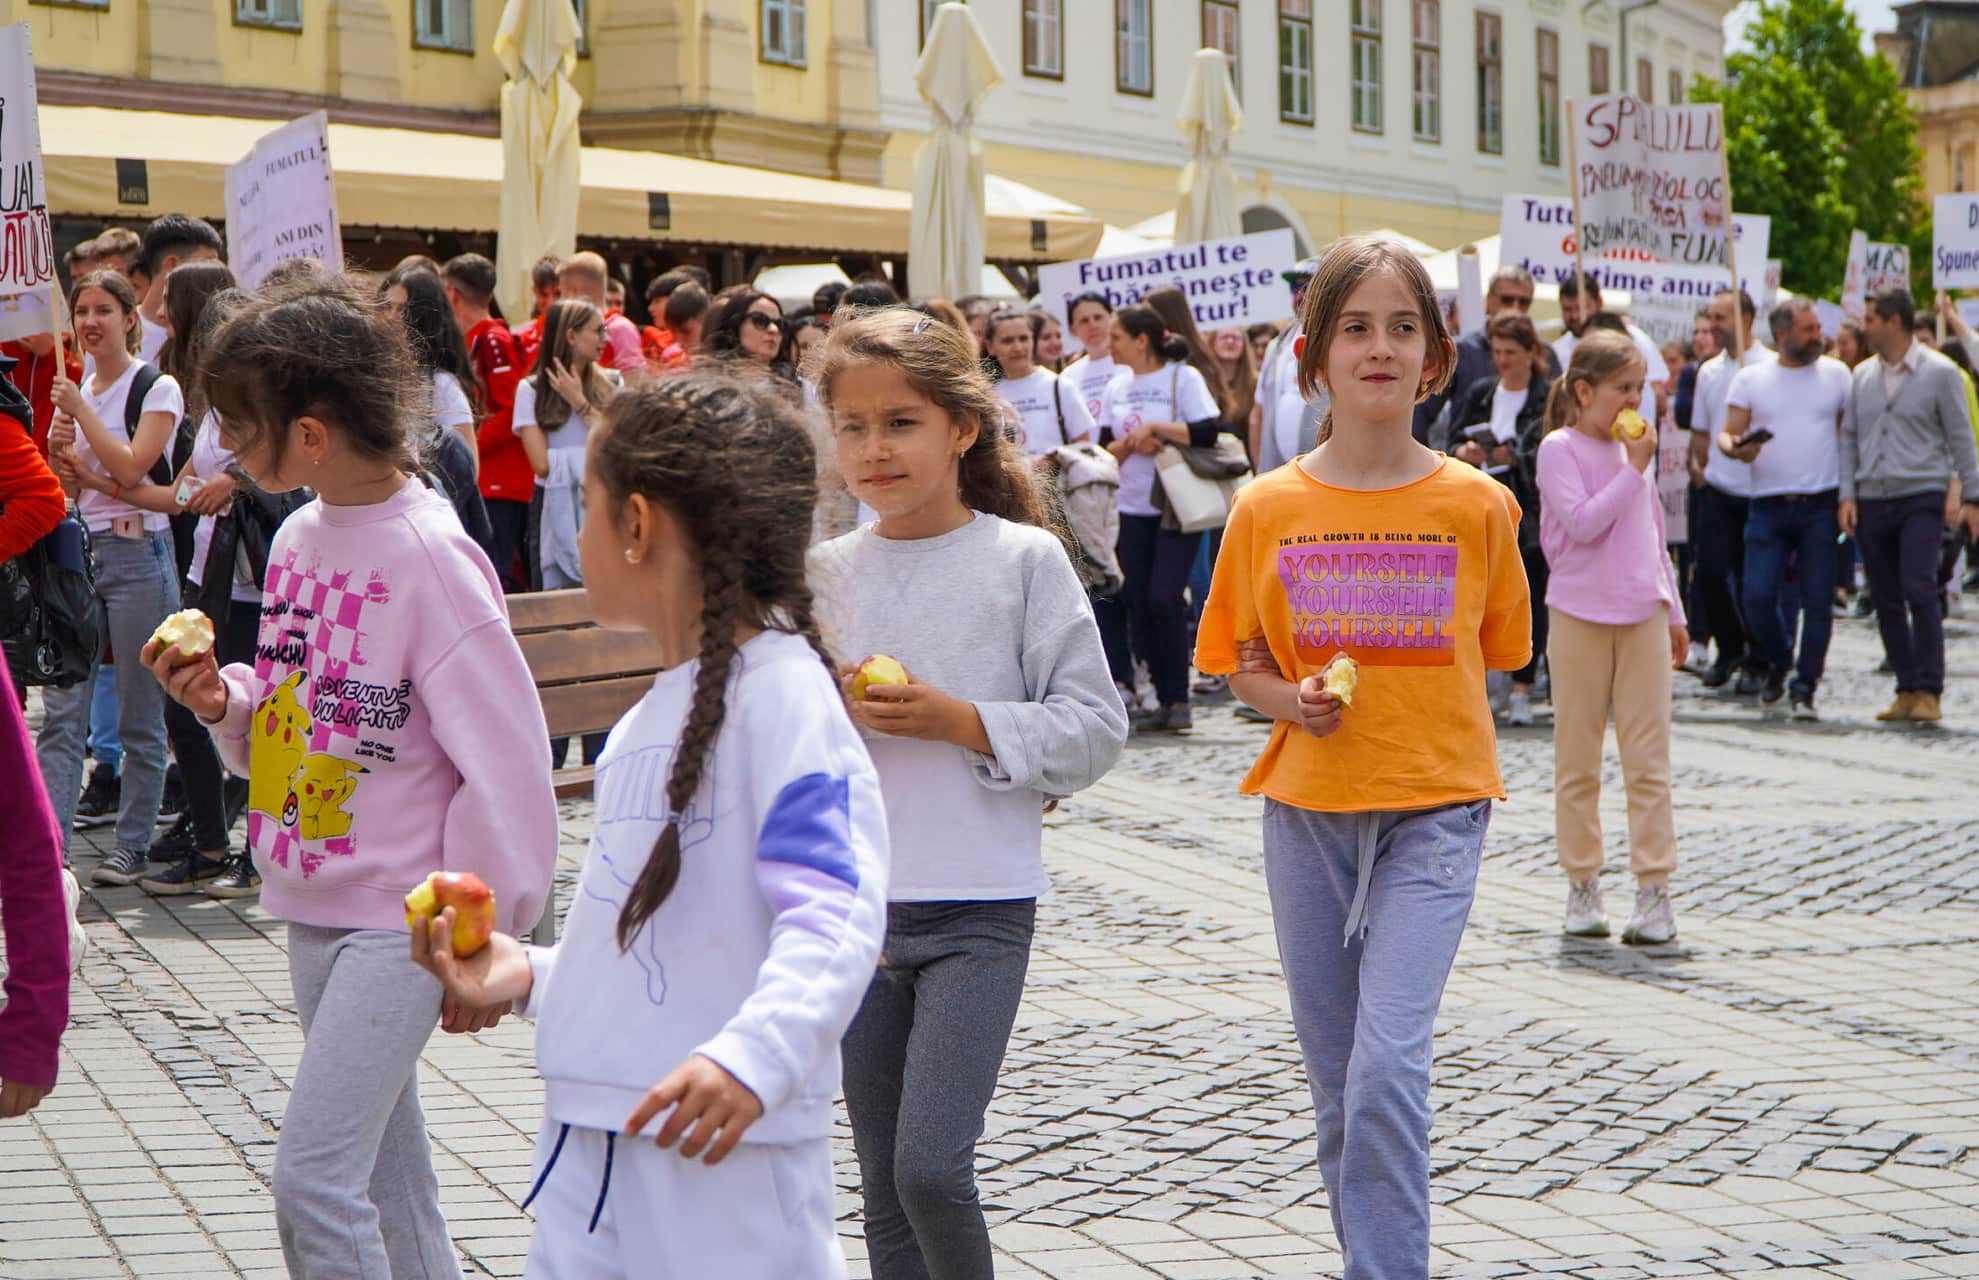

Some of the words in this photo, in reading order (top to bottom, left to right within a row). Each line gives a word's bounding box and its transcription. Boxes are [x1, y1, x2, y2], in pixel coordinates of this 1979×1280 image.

[1562, 234, 1577, 255] 6
[1079, 244, 1207, 286] Fumatul
[1217, 244, 1247, 264] te
[1192, 296, 1248, 323] tur!
[1279, 537, 1293, 547] THE
[1297, 534, 1318, 544] REAL
[1323, 532, 1365, 542] GROWTH
[1369, 532, 1380, 541] IS
[1384, 533, 1413, 542] BEING
[1417, 534, 1442, 543] MORE
[1283, 552, 1449, 584] YOURSELF
[1289, 584, 1448, 617] YOURSELF
[1293, 617, 1448, 649] YOURSELF
[355, 748, 374, 757] LIKE
[376, 751, 396, 763] YOU
[360, 739, 374, 748] NO
[375, 742, 395, 754] ONE
